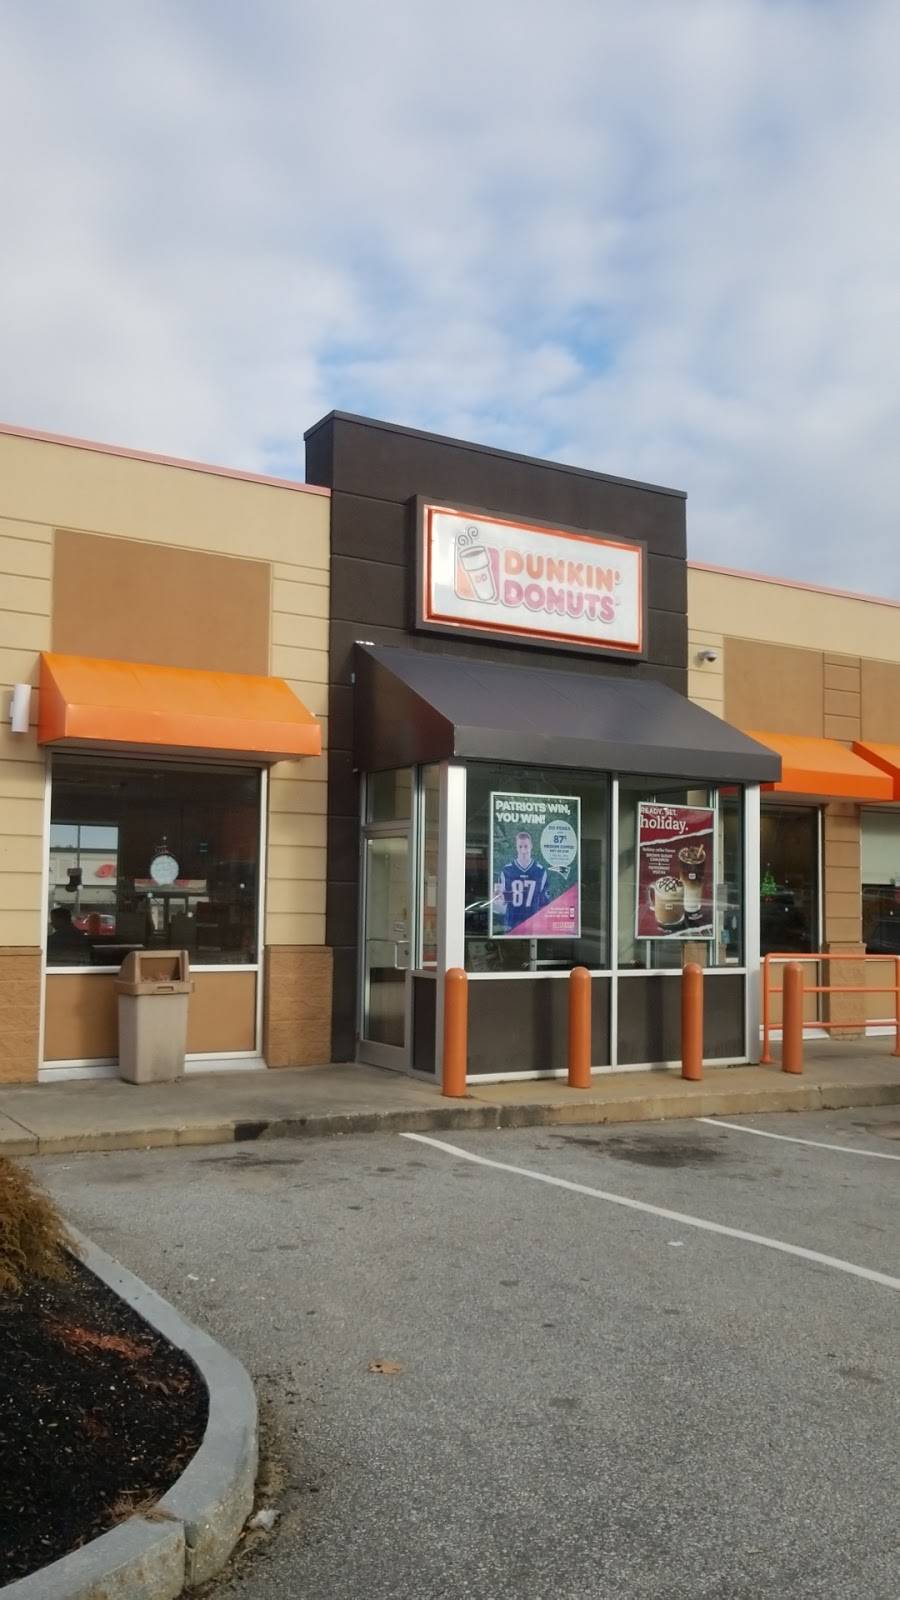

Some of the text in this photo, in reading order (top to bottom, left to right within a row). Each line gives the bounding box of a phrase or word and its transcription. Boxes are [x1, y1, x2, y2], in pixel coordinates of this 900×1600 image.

[504, 549, 621, 592] DUNKIN'
[502, 579, 617, 622] DONUTS
[495, 800, 571, 815] PATRIOTS WIN,
[496, 812, 546, 824] YOU WIN!
[640, 814, 689, 834] holiday.
[511, 879, 536, 907] 87
